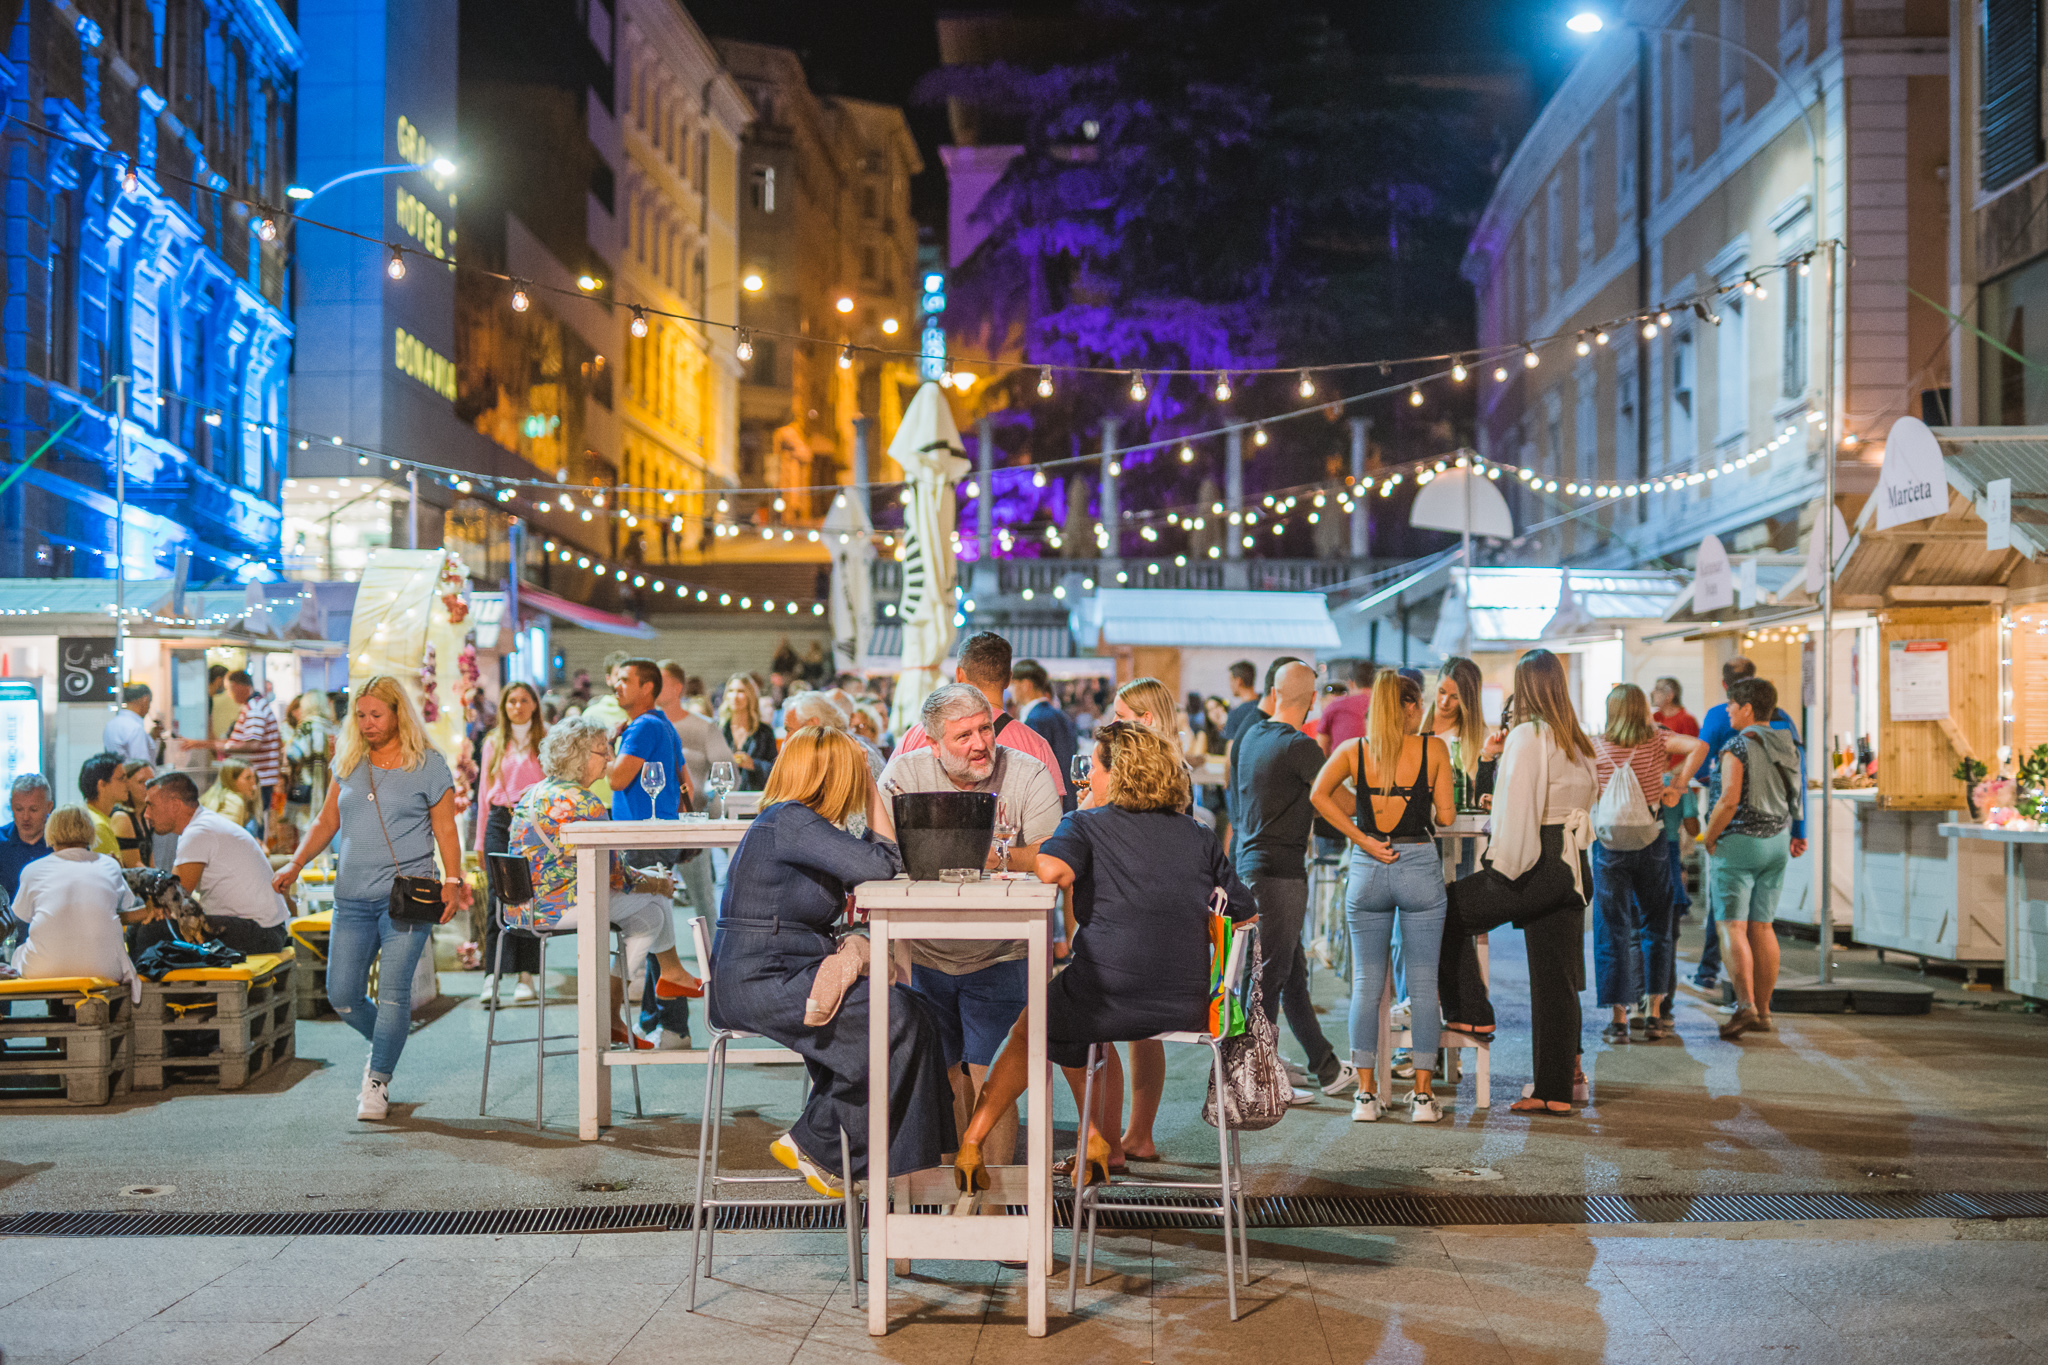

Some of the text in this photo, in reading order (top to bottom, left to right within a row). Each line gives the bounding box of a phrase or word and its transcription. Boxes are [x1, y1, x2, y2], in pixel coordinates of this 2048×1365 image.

[396, 115, 445, 192] GRAN
[396, 185, 445, 260] HOTEL
[395, 327, 457, 402] BONAVIA
[1887, 480, 1933, 509] Marčeta
